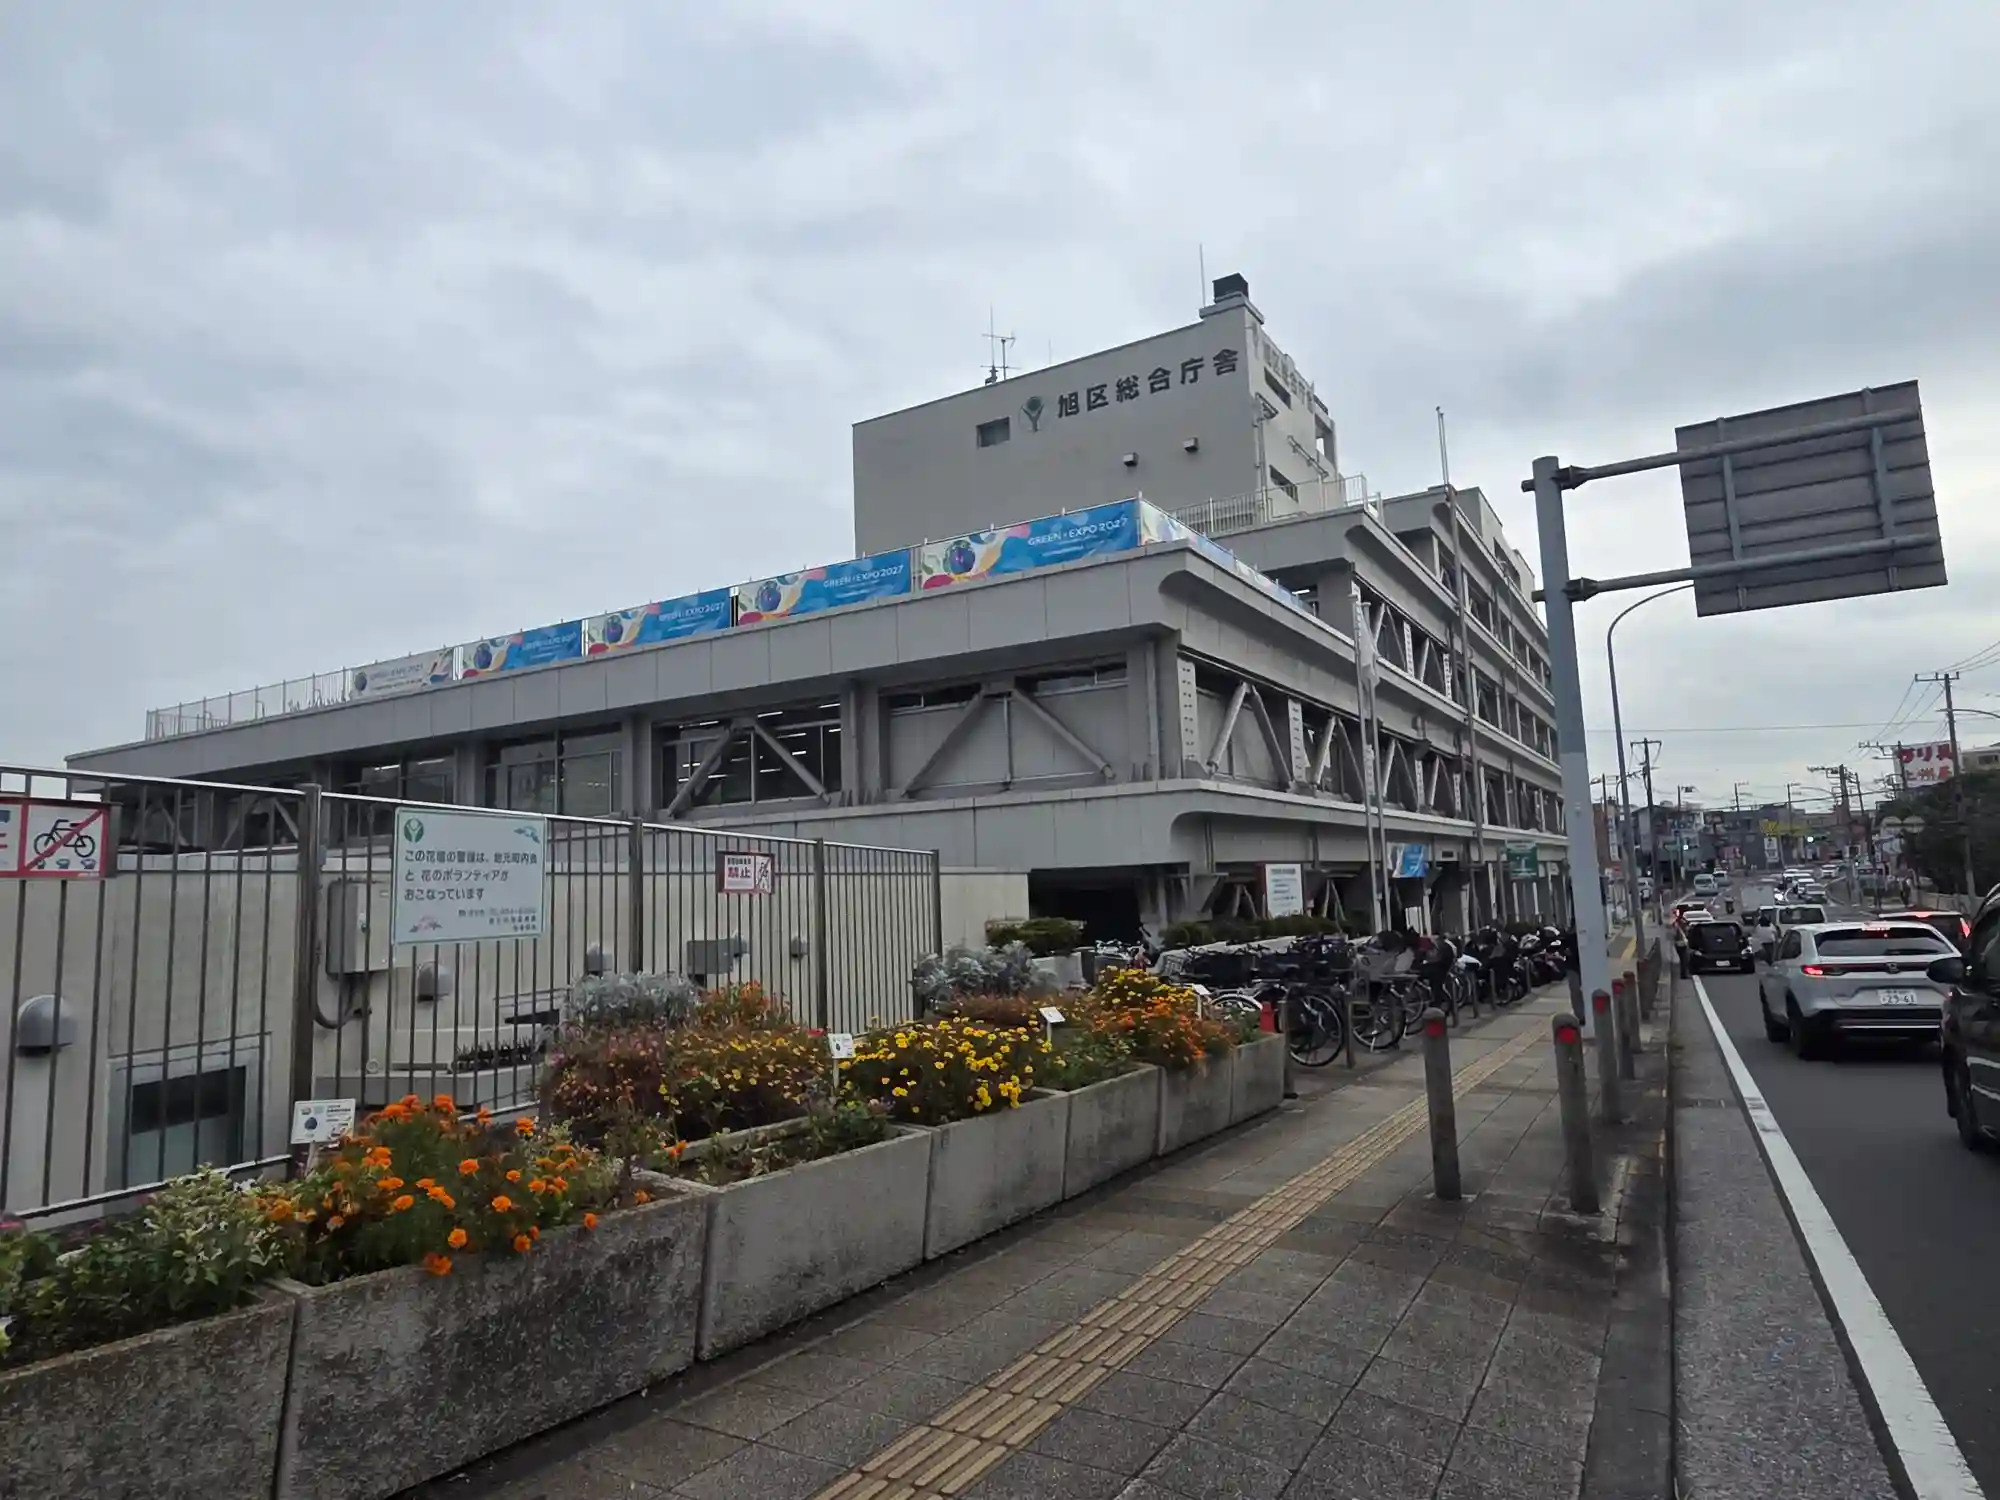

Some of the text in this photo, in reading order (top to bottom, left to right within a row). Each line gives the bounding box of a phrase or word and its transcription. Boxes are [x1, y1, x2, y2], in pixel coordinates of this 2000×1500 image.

[1057, 348, 1239, 418] 旭区総合庁舎
[880, 564, 904, 577] 2027
[404, 888, 485, 901] おこなっています
